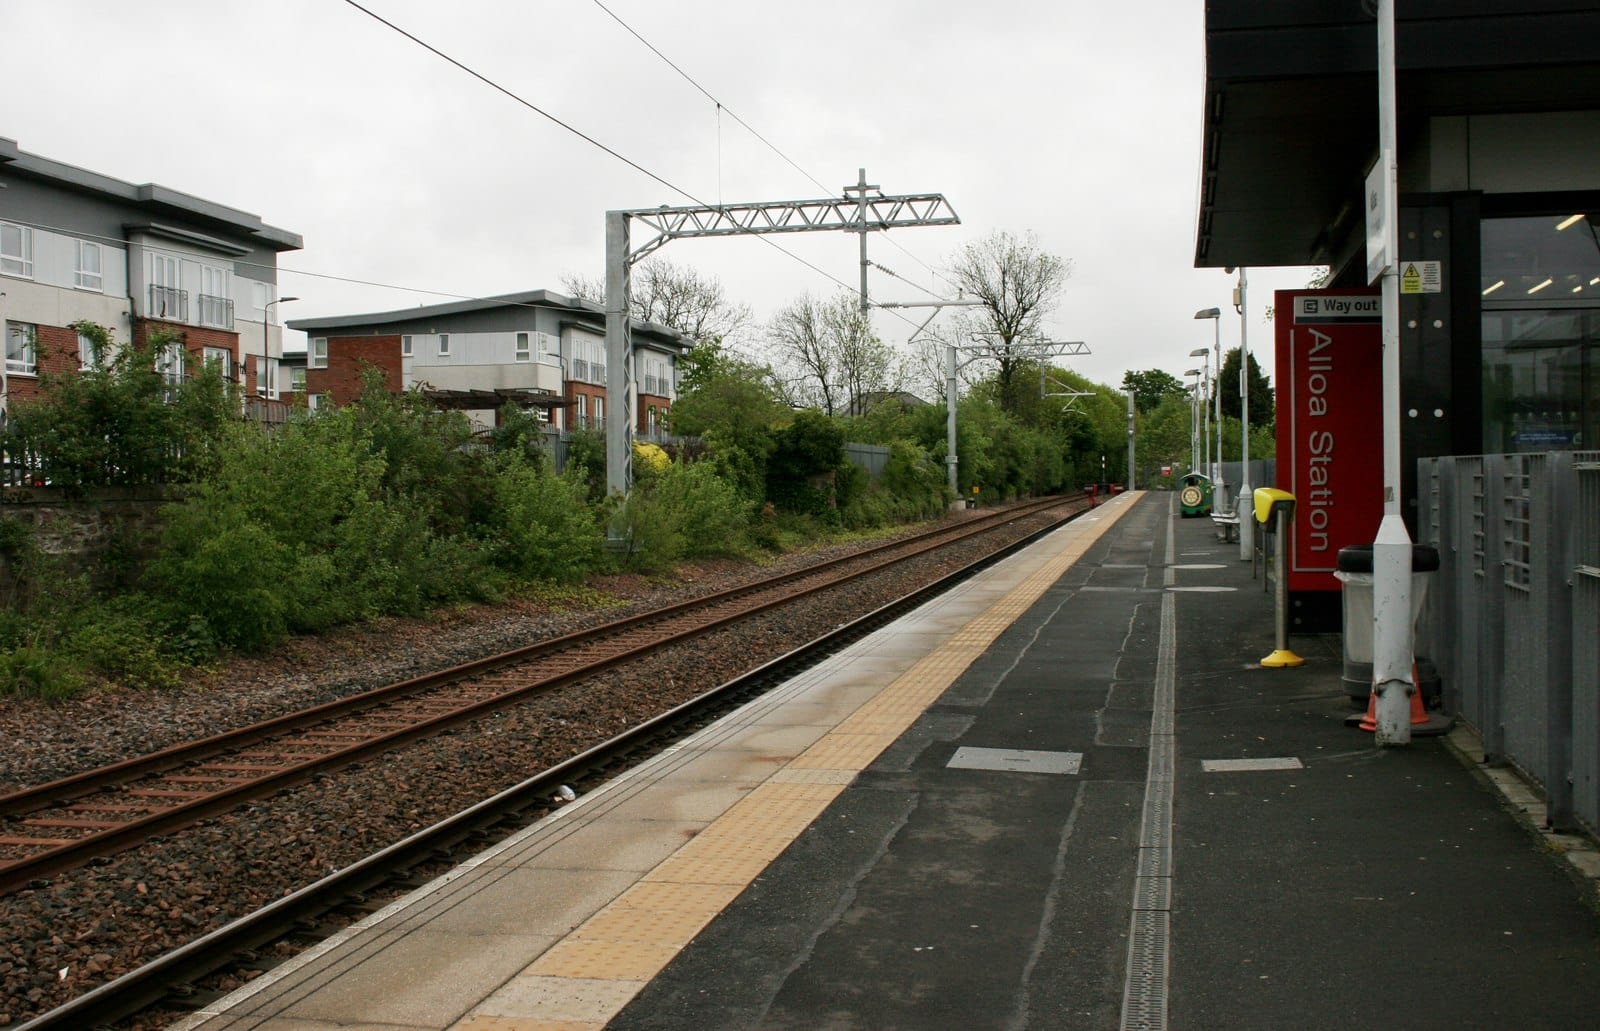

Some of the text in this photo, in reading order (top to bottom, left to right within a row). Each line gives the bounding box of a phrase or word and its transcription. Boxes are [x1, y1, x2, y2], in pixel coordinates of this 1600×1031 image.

[1324, 299, 1378, 314] Way out
[1308, 327, 1334, 551] Alloa Station
